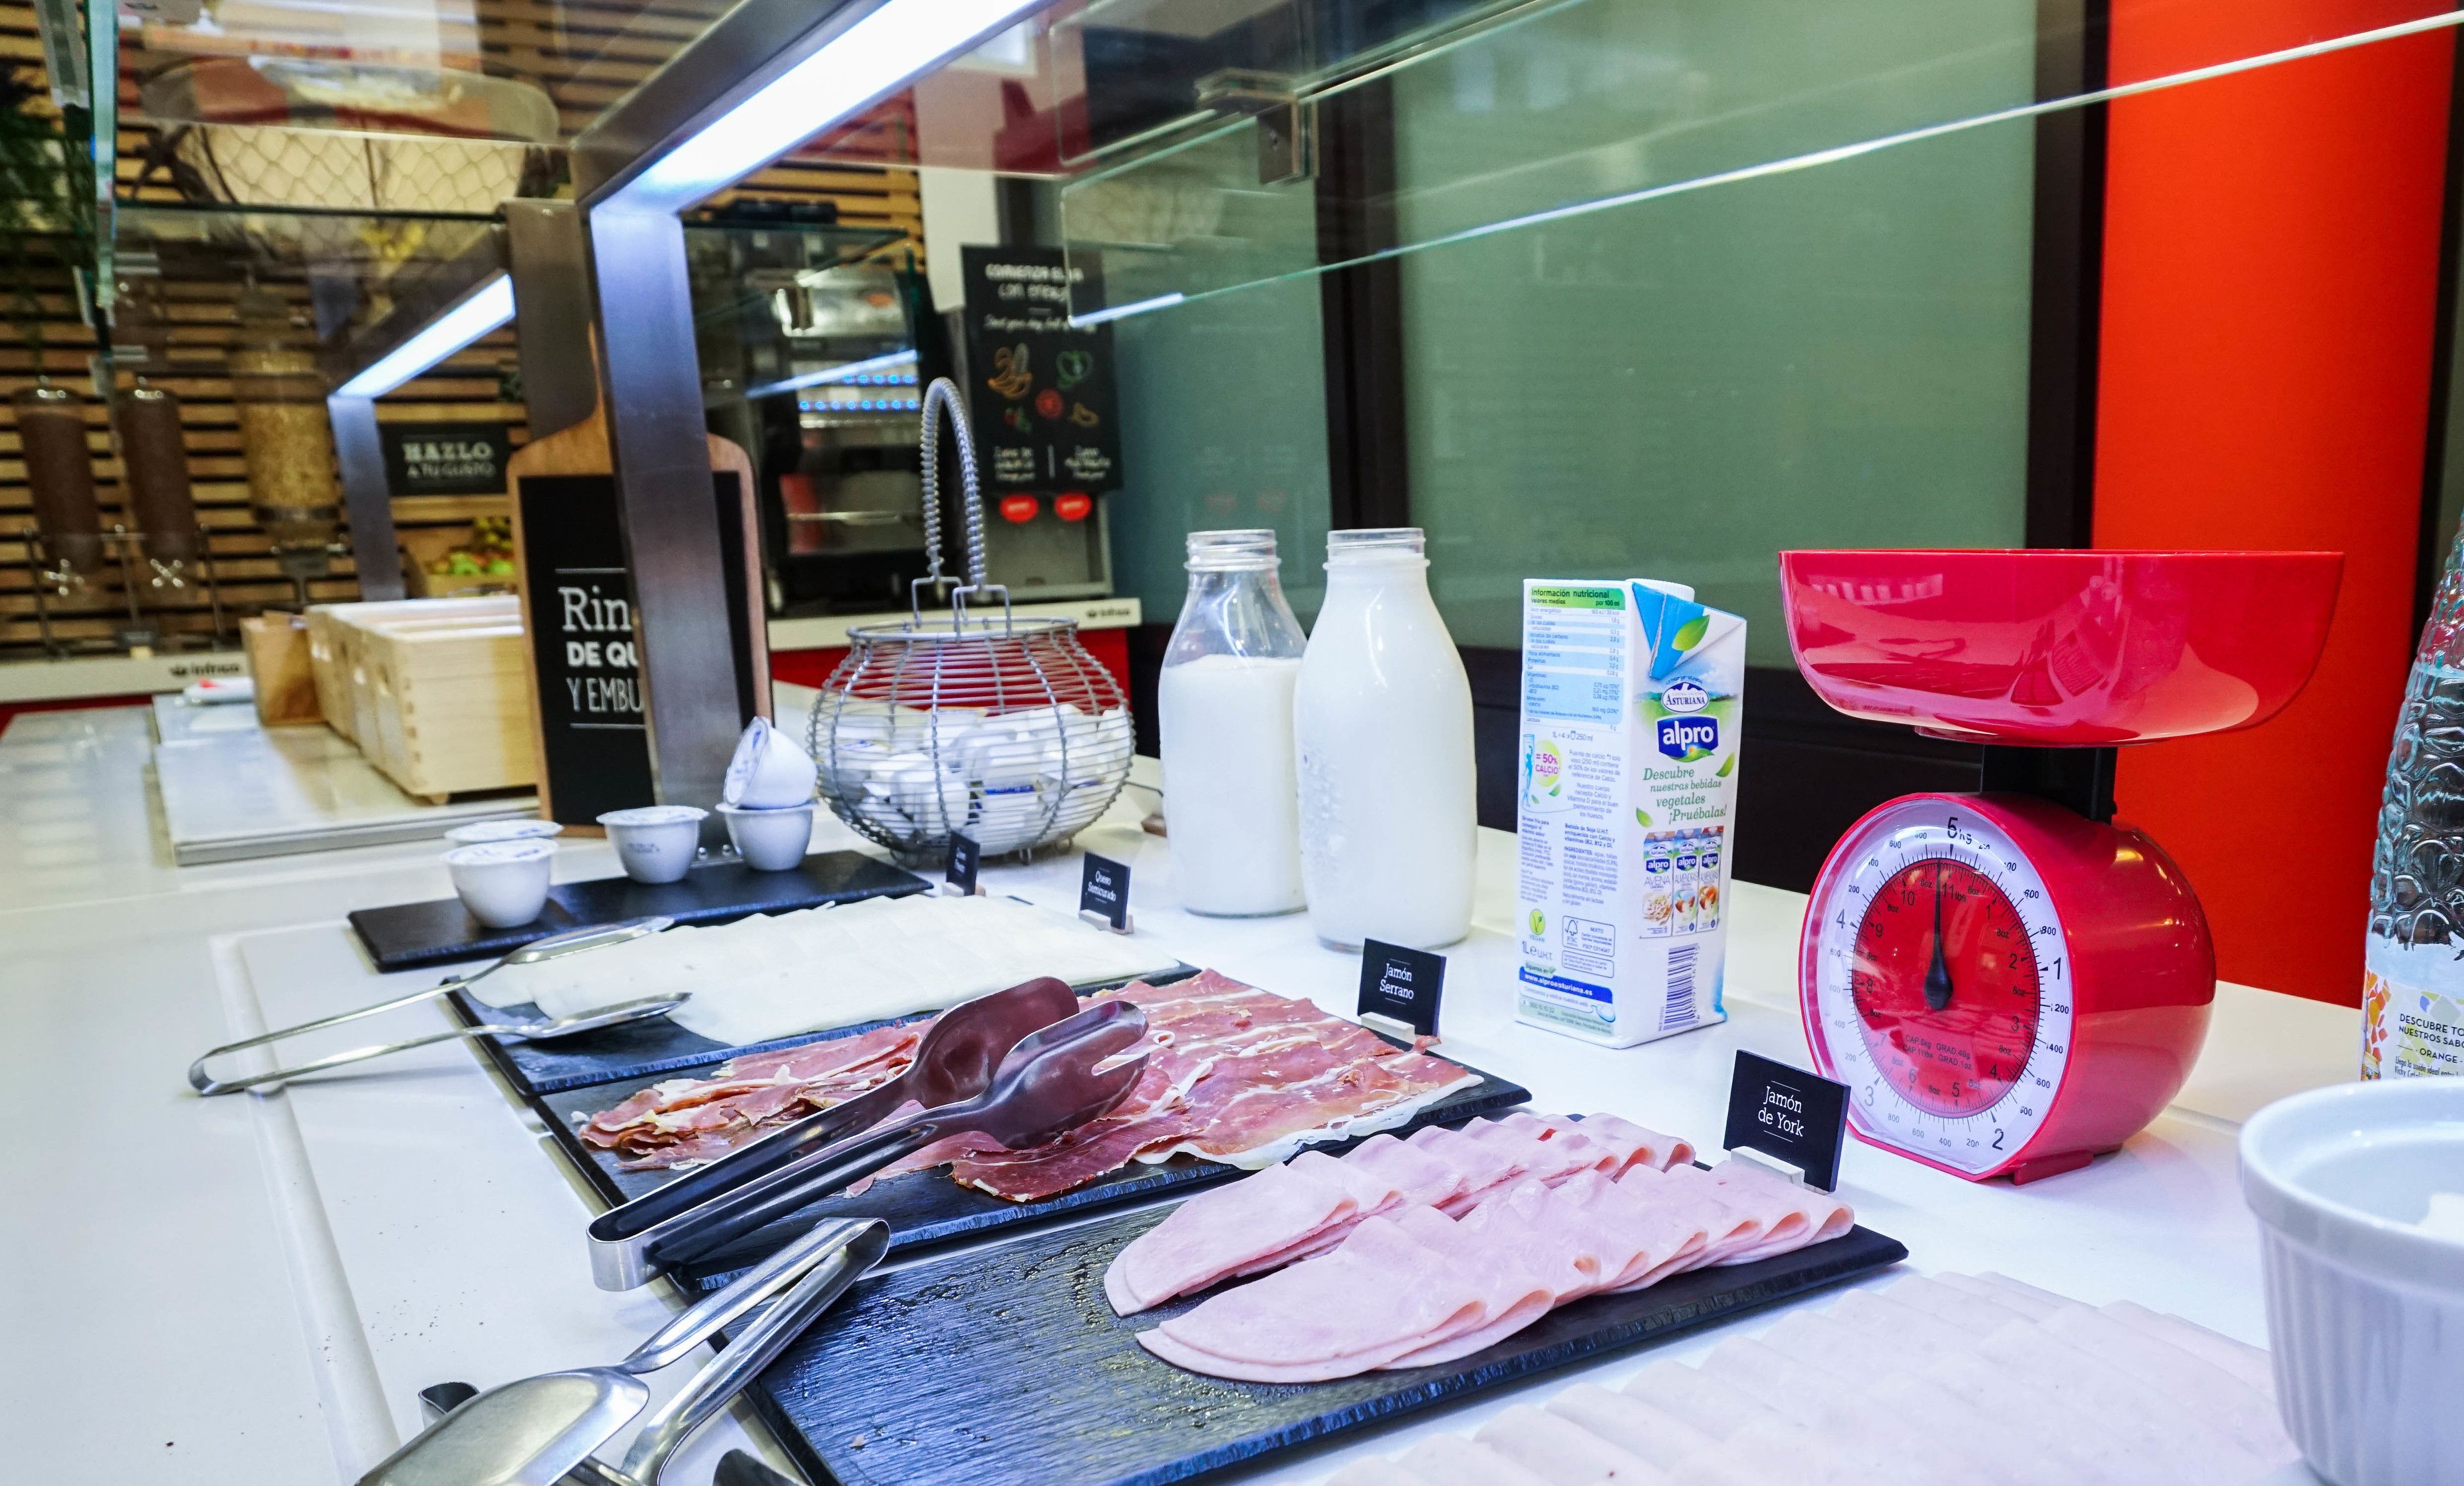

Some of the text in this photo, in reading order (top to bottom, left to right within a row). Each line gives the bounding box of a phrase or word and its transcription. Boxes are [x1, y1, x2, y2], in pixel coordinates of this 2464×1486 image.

[402, 441, 493, 462] HAZLO
[407, 462, 496, 478] A TU GUSTO
[1532, 588, 1609, 598] Información nutricional
[566, 641, 602, 668] DE
[566, 677, 581, 713] Y
[1666, 694, 1706, 705] ASTURIANA
[1663, 721, 1714, 751] alpro
[1543, 753, 1557, 764] 50%
[1643, 765, 1695, 780] Descubre
[1650, 778, 1722, 792] nuestras bebidas
[1656, 792, 1706, 810] vegetales
[1669, 804, 1727, 825] ¡Pruébalas!
[1889, 839, 1901, 849] 600
[1648, 854, 1718, 871] alpro alpro alpro
[1645, 875, 1670, 886] AVENA
[1849, 884, 1860, 894] 200
[2024, 889, 2039, 899] 600
[1901, 889, 1915, 906] 10
[1887, 903, 1899, 914] 8oz
[1985, 905, 1991, 920] 1
[1836, 909, 1845, 929] 4
[1876, 923, 1883, 937] 9
[1522, 941, 1529, 954] 1L
[2008, 953, 2017, 969] 2
[2053, 957, 2062, 980] 1
[1383, 963, 1412, 982] Jamón
[1380, 979, 1414, 999] Serrano
[1525, 973, 1593, 996] www.alproasturiana.es
[1867, 978, 1874, 994] 8
[2012, 986, 2026, 996] 8oz
[2055, 1003, 2069, 1014] 200
[1834, 1019, 1845, 1029] 400
[2011, 1016, 2020, 1032] 3
[2400, 1013, 2448, 1034] DESCUBRE
[1880, 1032, 1887, 1045] 7
[2399, 1025, 2441, 1043] NUESTROS
[2048, 1042, 2064, 1054] 400
[1845, 1052, 1856, 1062] 200
[2420, 1048, 2458, 1064] ORANGE
[1909, 1068, 1917, 1084] 6
[1990, 1063, 1998, 1079] 4
[2427, 1065, 2440, 1075] ideal
[1952, 1082, 1960, 1097] 5
[1968, 1079, 1981, 1089] 8oz
[2036, 1077, 2051, 1089] 600
[1763, 1086, 1802, 1113] Jamón
[1864, 1085, 1875, 1107] 3
[1758, 1107, 1804, 1136] de York
[1888, 1113, 1900, 1123] 800
[1912, 1128, 1924, 1139] 600
[1992, 1128, 2005, 1151] 2
[1939, 1137, 1952, 1147] 400
